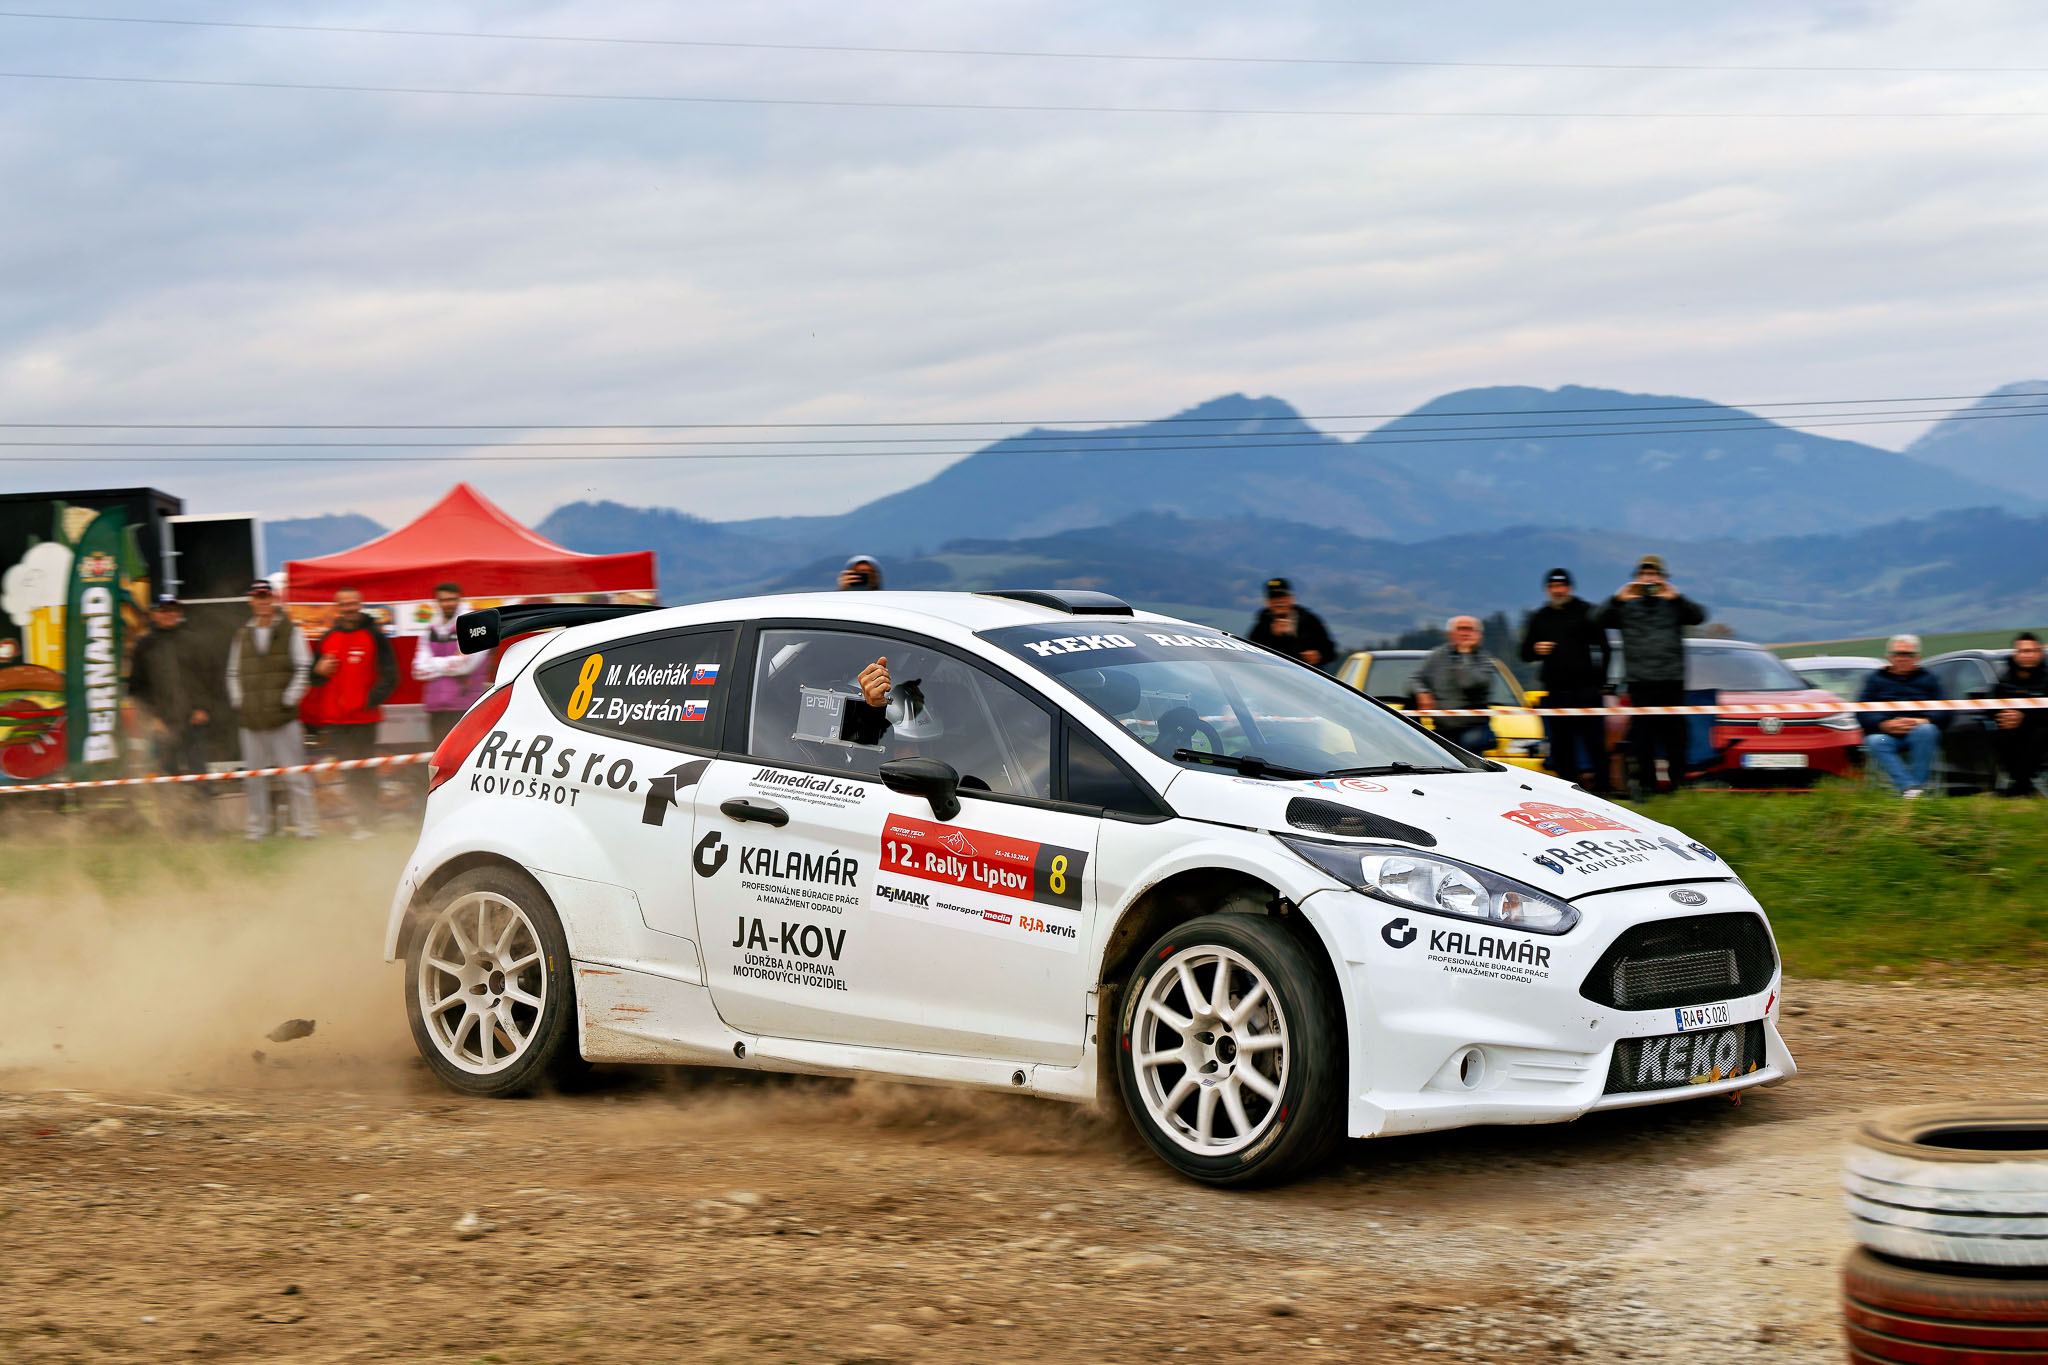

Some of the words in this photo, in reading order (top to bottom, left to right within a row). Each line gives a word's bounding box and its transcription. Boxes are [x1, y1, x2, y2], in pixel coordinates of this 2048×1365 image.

[1023, 634, 1137, 657] KEKO
[80, 586, 119, 763] BERNARD
[567, 653, 604, 720] 8
[605, 664, 621, 686] M.
[625, 663, 690, 686] Kekeňák
[475, 730, 554, 775] R+R
[552, 748, 577, 779] s
[581, 753, 638, 793] r.o.
[470, 773, 580, 807] KOVOŠROT
[752, 768, 835, 793] JMmedical
[832, 783, 867, 799] s.r.o.
[886, 840, 920, 869] 12.
[925, 852, 968, 882] Rally
[972, 861, 1028, 891] Liptov
[1544, 840, 1614, 865] R+R
[1575, 853, 1650, 875] KOVOŠROT
[739, 846, 859, 888] KALAMÁR
[1049, 854, 1068, 895] 8
[741, 881, 800, 896] PROFESIONÁLNE
[801, 888, 834, 902] BÚRACIE
[835, 894, 859, 906] PRÁCE
[756, 894, 763, 902] A
[763, 895, 810, 910] MANAŽMENT
[811, 903, 843, 914] ODPADU
[732, 916, 847, 961] JA-KOV
[1429, 929, 1551, 968] KALAMÁR
[733, 965, 801, 984] MOTOROVÝCH
[803, 974, 848, 991] VOZIDIEL
[744, 952, 784, 970] ÚDRŽBA
[786, 960, 793, 971] A
[795, 961, 835, 976] OPRAVA
[1427, 955, 1490, 969] PROFESIONÁLNE
[1491, 963, 1523, 974] BÚRACIE
[1524, 969, 1549, 979] PRÁCE
[1450, 966, 1499, 979] MANAŽMENT
[1500, 973, 1532, 984] ODPADU
[1683, 1010, 1697, 1027] RA
[1636, 1030, 1737, 1083] KEKO
